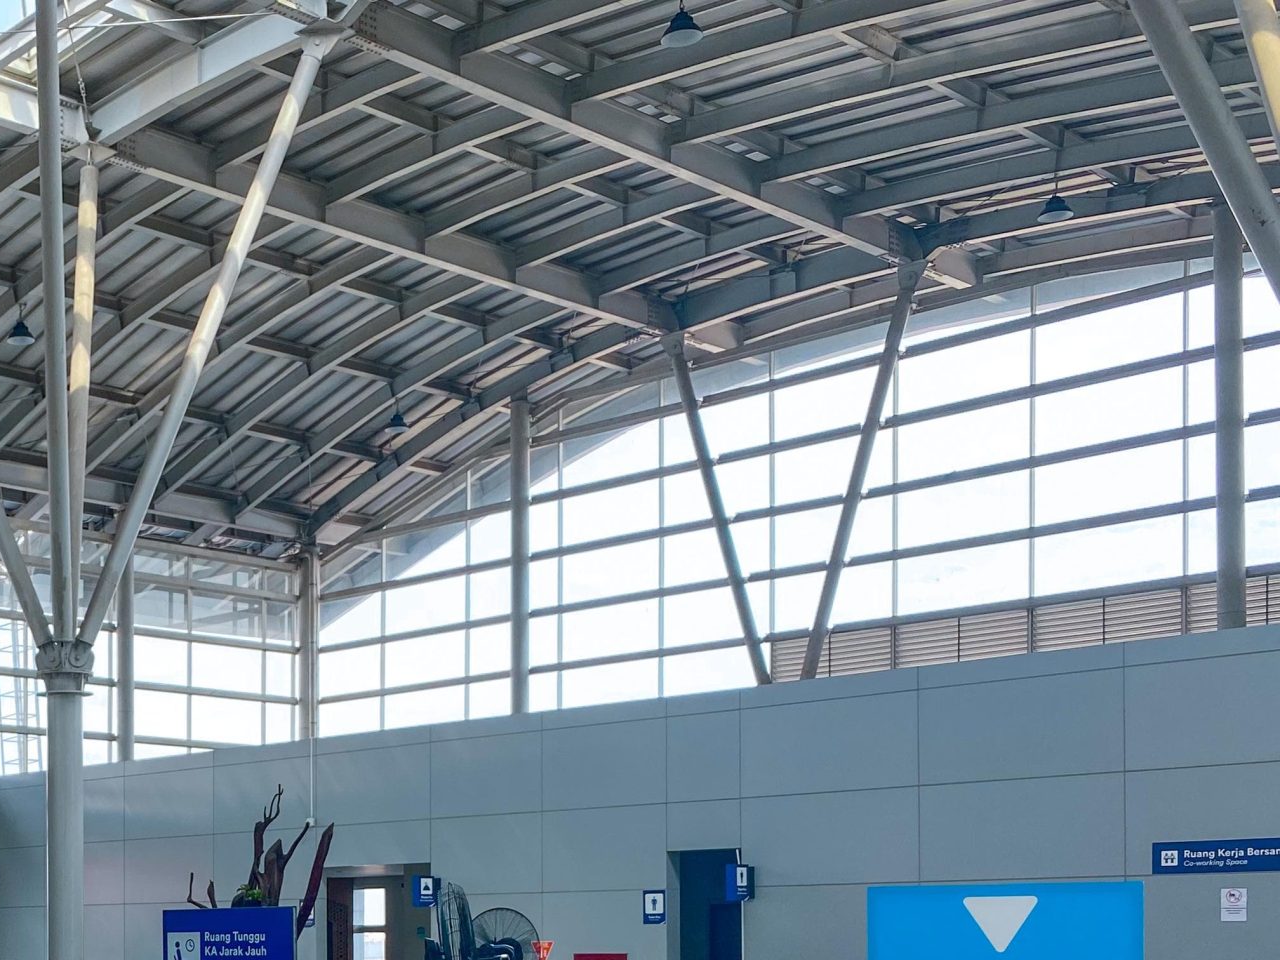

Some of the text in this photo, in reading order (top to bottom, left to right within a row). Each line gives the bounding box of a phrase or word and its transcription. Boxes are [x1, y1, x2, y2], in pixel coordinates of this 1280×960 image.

[1184, 849, 1215, 859] Ruang
[1217, 847, 1244, 858] Kerja
[1184, 858, 1248, 867] Co-working Space
[204, 931, 266, 944] Ruang Tunggu
[204, 945, 267, 956] KA Jarak Jauh
